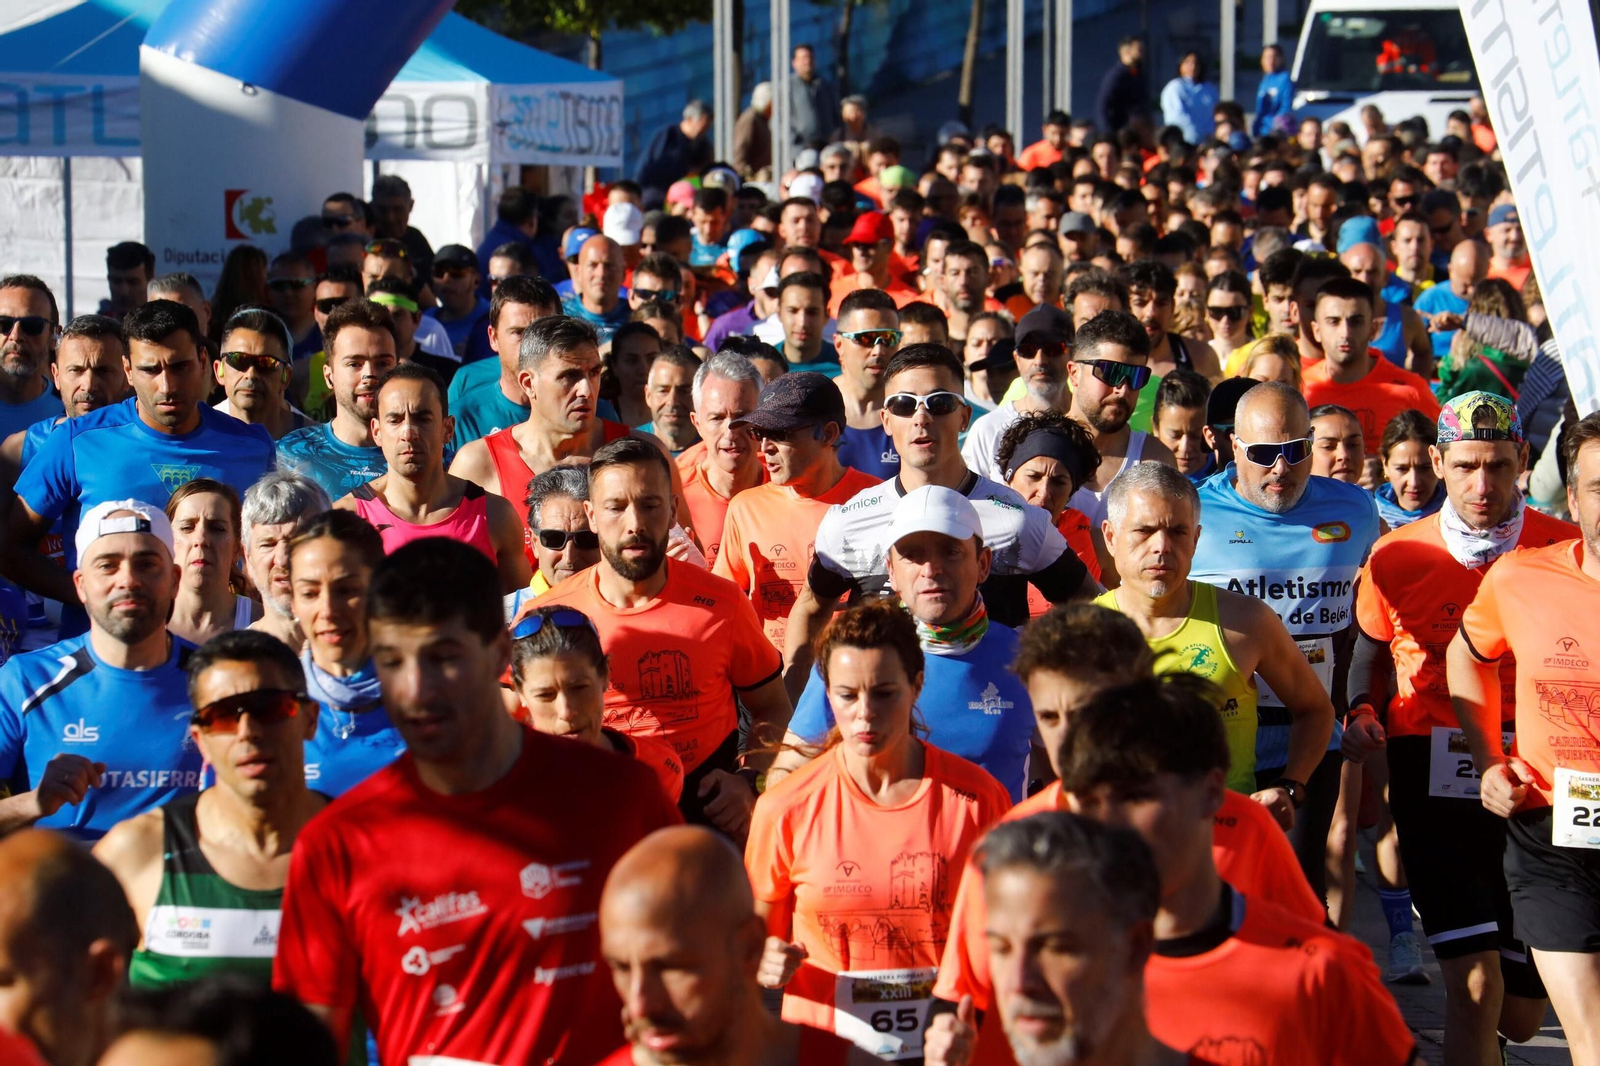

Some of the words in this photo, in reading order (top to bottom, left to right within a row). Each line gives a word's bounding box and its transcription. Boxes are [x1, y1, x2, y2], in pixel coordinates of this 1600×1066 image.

[164, 248, 226, 265] Diputaci
[881, 449, 899, 463] als
[1227, 576, 1351, 600] Atletismo
[1289, 608, 1315, 625] de
[1553, 658, 1589, 667] IMDECO
[62, 718, 99, 743] als
[1548, 736, 1600, 748] CARRER
[1456, 760, 1481, 779] 2
[834, 885, 872, 893] IMDECO
[871, 1008, 918, 1033] 65
